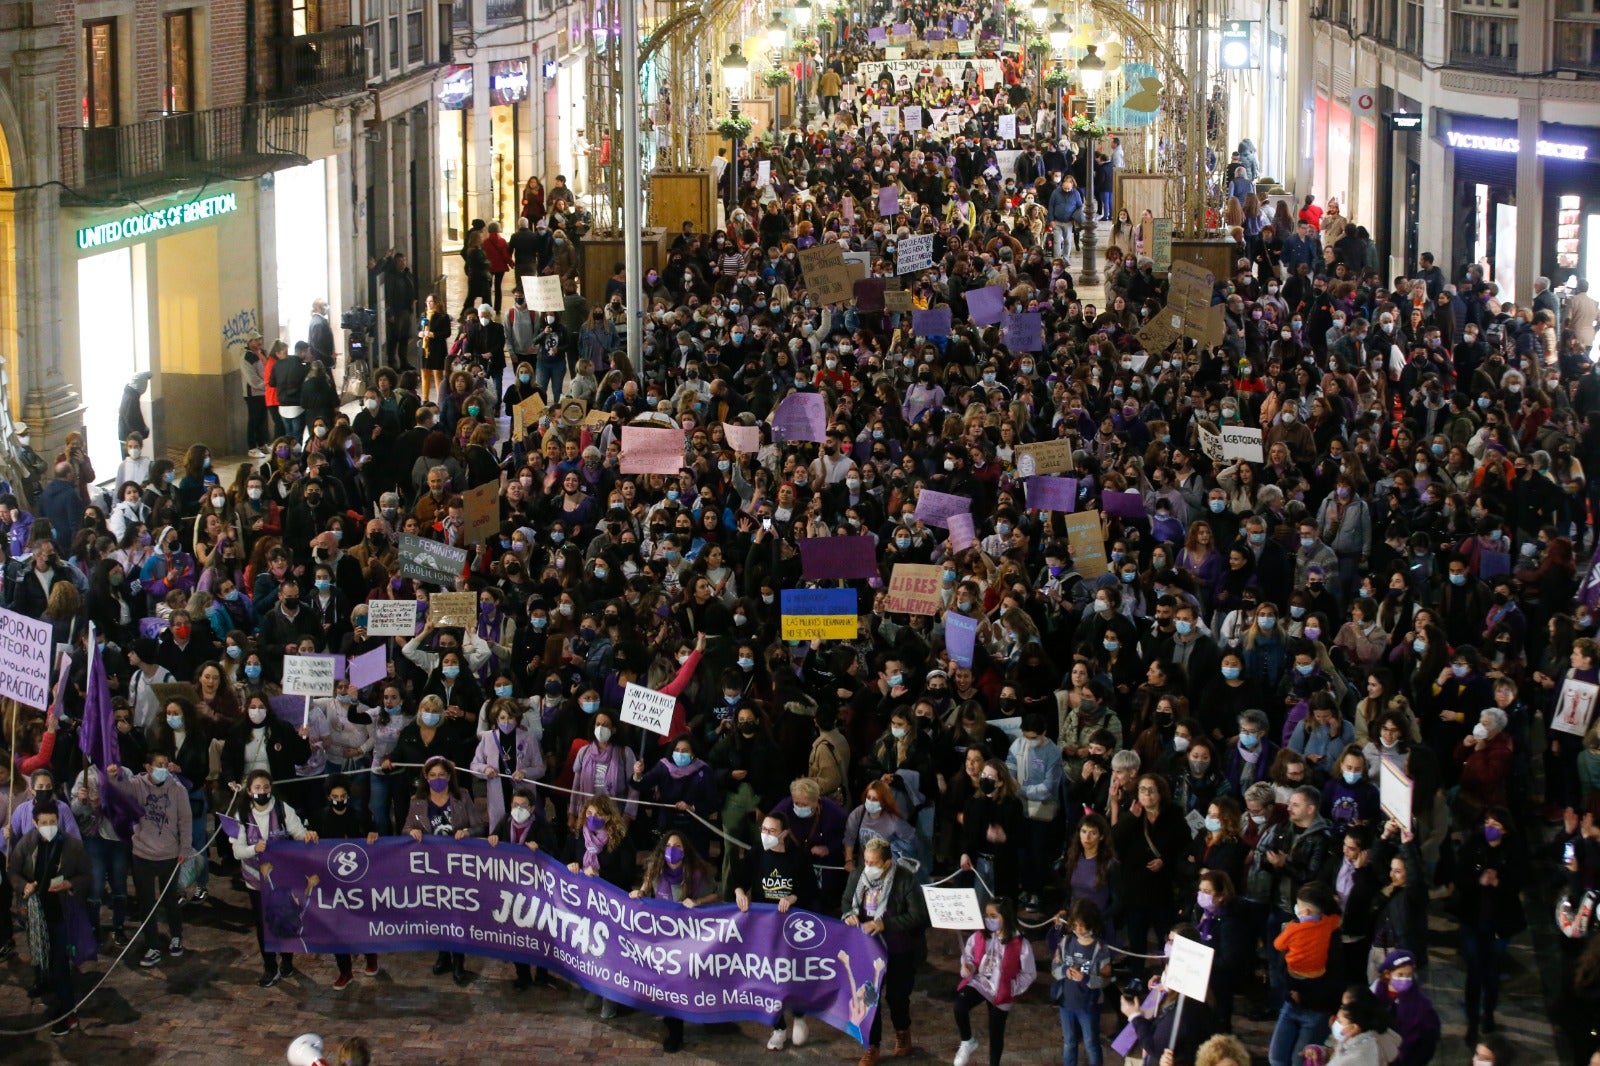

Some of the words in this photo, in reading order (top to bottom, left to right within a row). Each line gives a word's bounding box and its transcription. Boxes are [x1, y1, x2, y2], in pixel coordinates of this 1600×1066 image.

[1447, 132, 1520, 152] VICTORIA'S
[1536, 140, 1588, 160] SECRET
[78, 222, 121, 249] UNITED
[123, 209, 167, 237] COLORS
[167, 204, 183, 227] OF
[404, 536, 416, 547] EL
[891, 577, 938, 595] LIBRES
[3, 615, 47, 645] PORNO
[4, 658, 47, 679] VIOLACIÓN
[0, 671, 45, 704] PRÁCTICA
[629, 699, 647, 711] NO
[649, 706, 664, 717] HAY
[632, 712, 661, 728] TRATA
[410, 852, 439, 875] EL
[447, 853, 556, 896] FEMINISMO
[560, 879, 582, 907] ES
[587, 891, 743, 943] ABOLICIONISTA
[317, 887, 364, 910] LAS
[371, 885, 480, 912] MUJERES
[492, 890, 610, 958] JUNTAS
[617, 934, 682, 976] SOMOS
[688, 951, 836, 984] IMPARABLES
[369, 920, 464, 937] Movimiento
[469, 926, 539, 950] feminista
[543, 942, 551, 955] y
[554, 946, 610, 982] asociativo
[614, 970, 631, 988] de
[633, 982, 689, 1005] mujeres
[694, 991, 717, 1007] de
[722, 989, 783, 1013] Málaga
